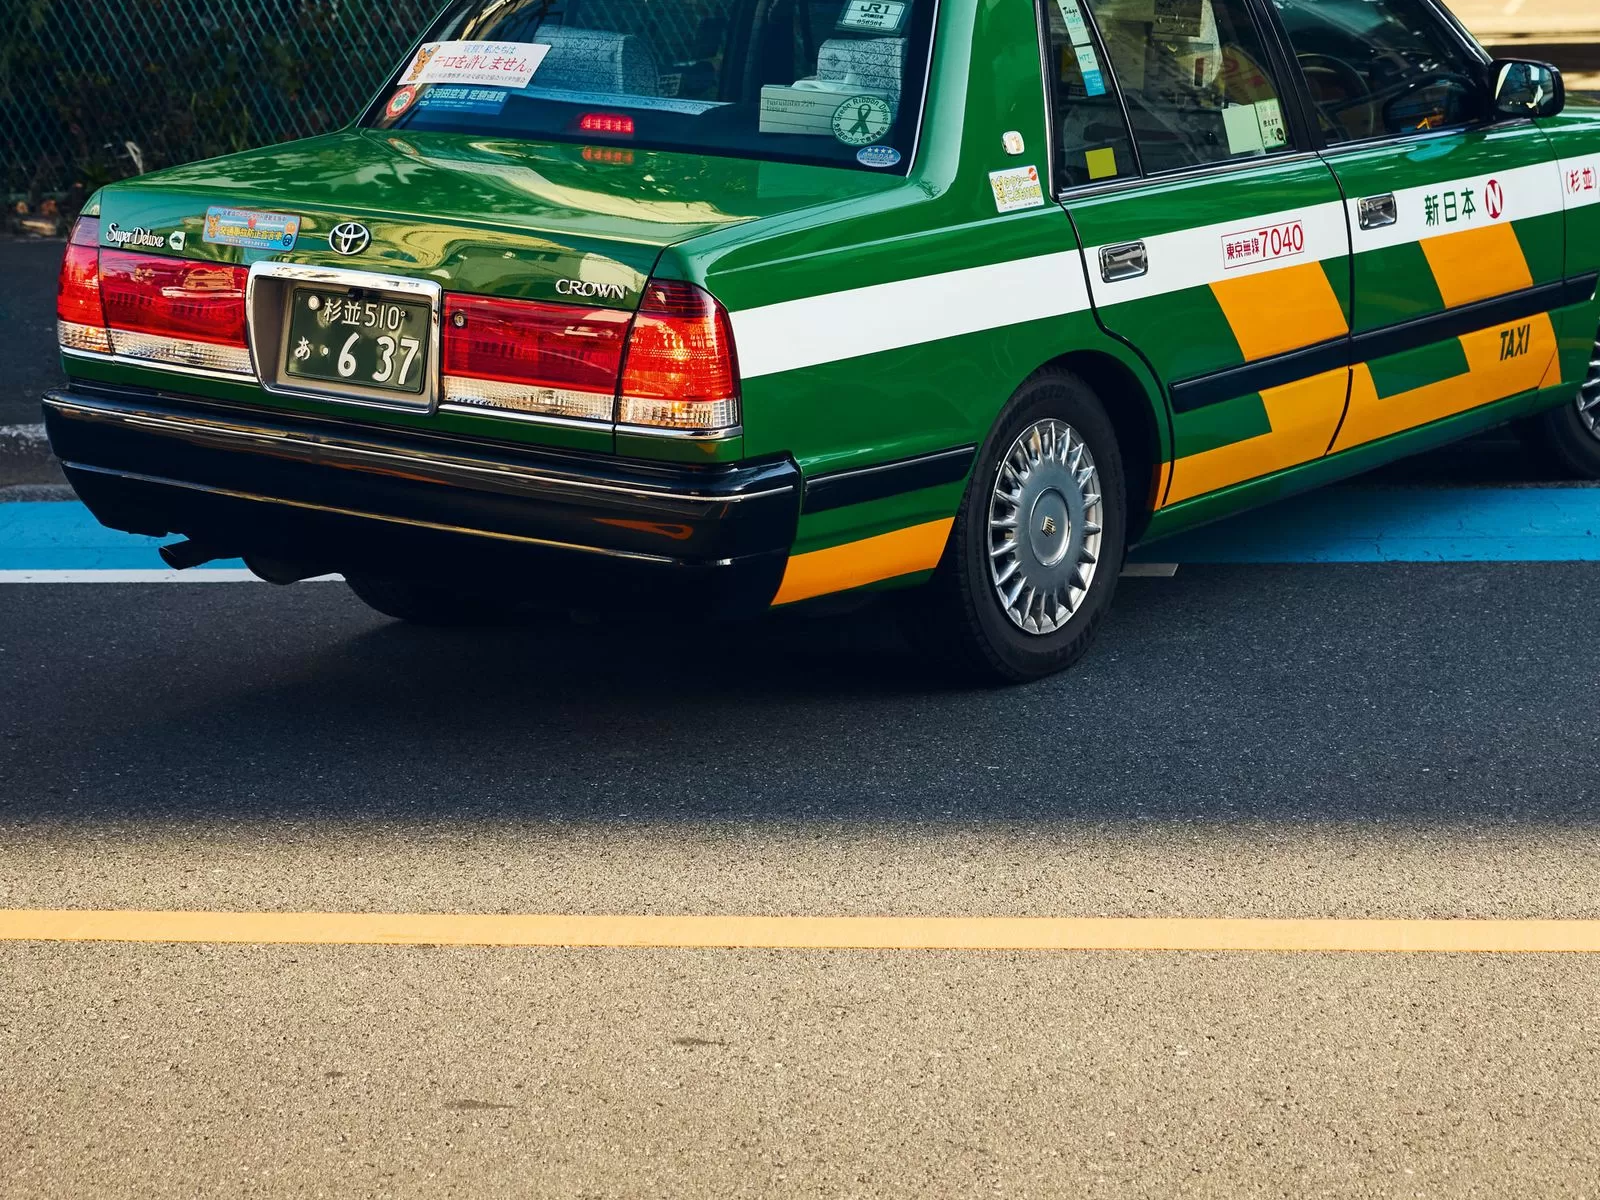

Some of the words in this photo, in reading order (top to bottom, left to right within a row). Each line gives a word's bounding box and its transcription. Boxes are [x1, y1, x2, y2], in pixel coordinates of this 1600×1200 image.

[434, 55, 532, 74] テロを許しません。
[853, 97, 879, 106] Ribbon
[1424, 187, 1477, 226] 新日本
[106, 223, 132, 246] Super
[131, 227, 165, 248] Deluxe
[1226, 237, 1259, 259] 東京無線
[1258, 224, 1304, 258] 7040
[555, 279, 626, 299] CROWN
[294, 336, 311, 361] あ
[1500, 324, 1531, 361] TAXI
